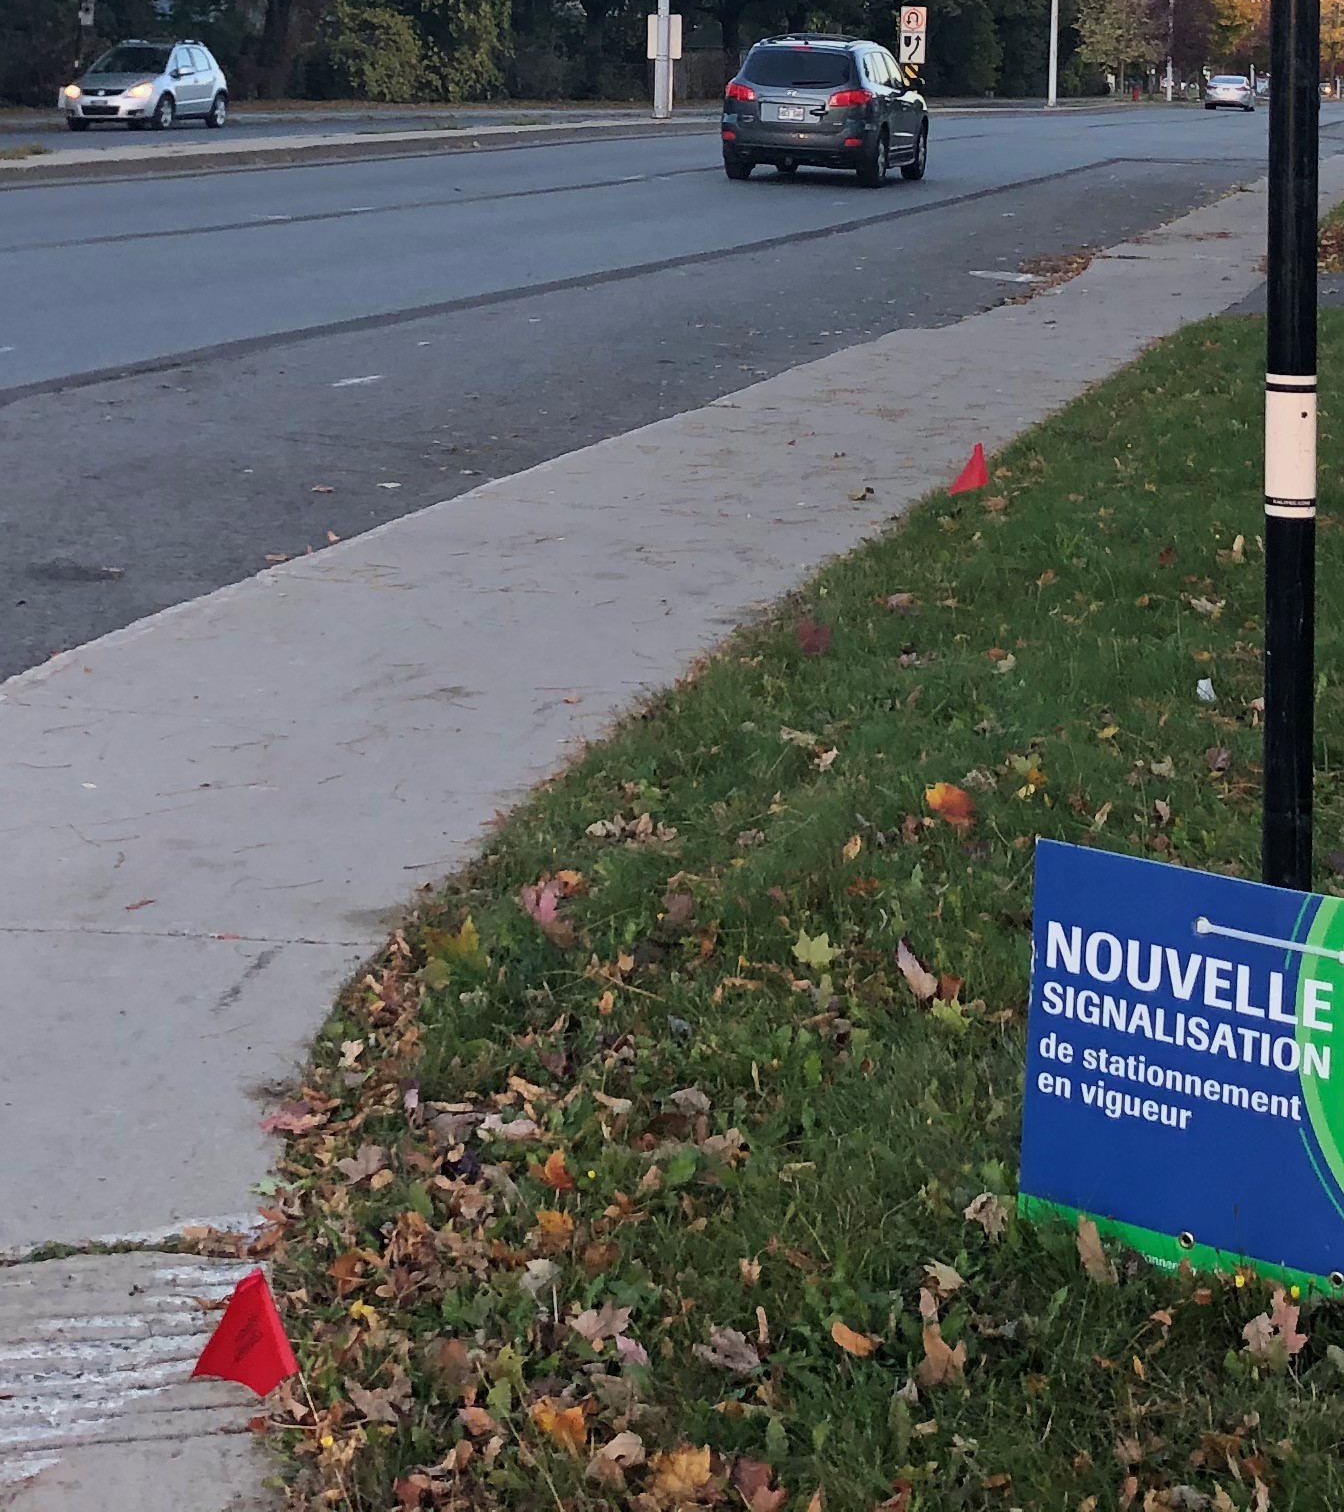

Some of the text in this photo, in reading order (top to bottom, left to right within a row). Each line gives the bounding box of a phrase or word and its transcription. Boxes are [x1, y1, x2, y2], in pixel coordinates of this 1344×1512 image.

[1045, 920, 1335, 1033] NOUVELLE
[1039, 1032, 1302, 1121] de stationnement
[1041, 981, 1332, 1080] SIGNALISATION
[1037, 1072, 1192, 1131] en vigueur
